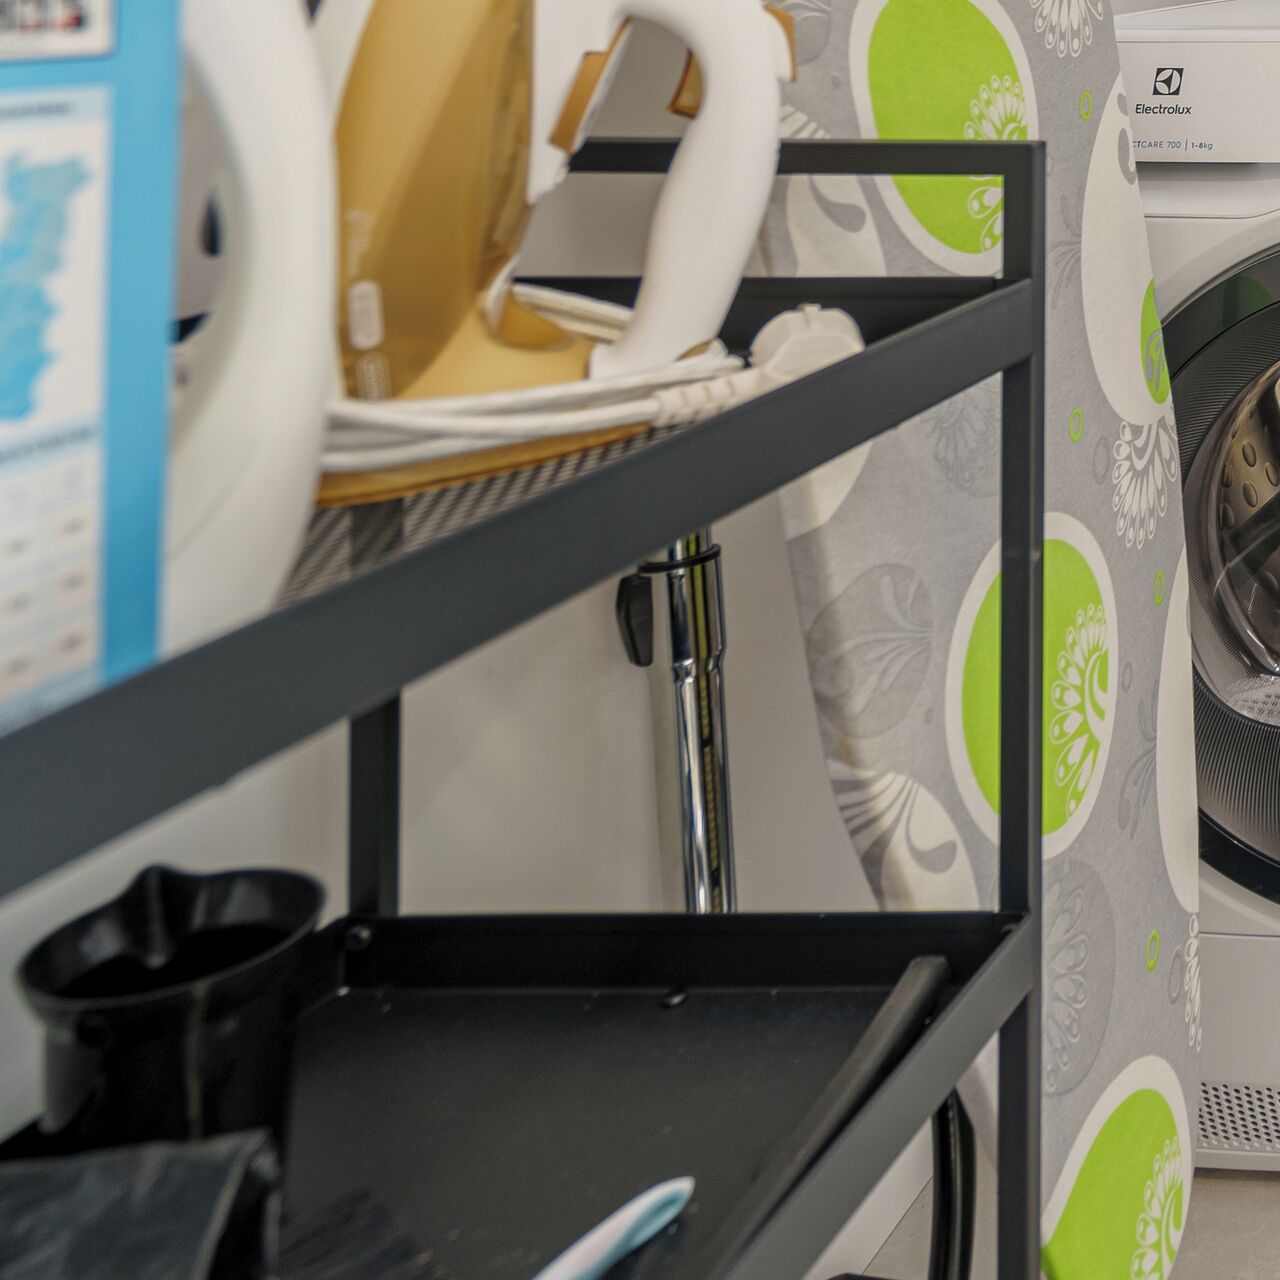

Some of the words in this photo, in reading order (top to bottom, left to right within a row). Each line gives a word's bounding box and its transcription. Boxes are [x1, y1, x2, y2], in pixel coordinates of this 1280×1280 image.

[1135, 103, 1192, 115] Electrolux
[1167, 140, 1181, 149] 700
[1191, 142, 1213, 151] 1-8kg
